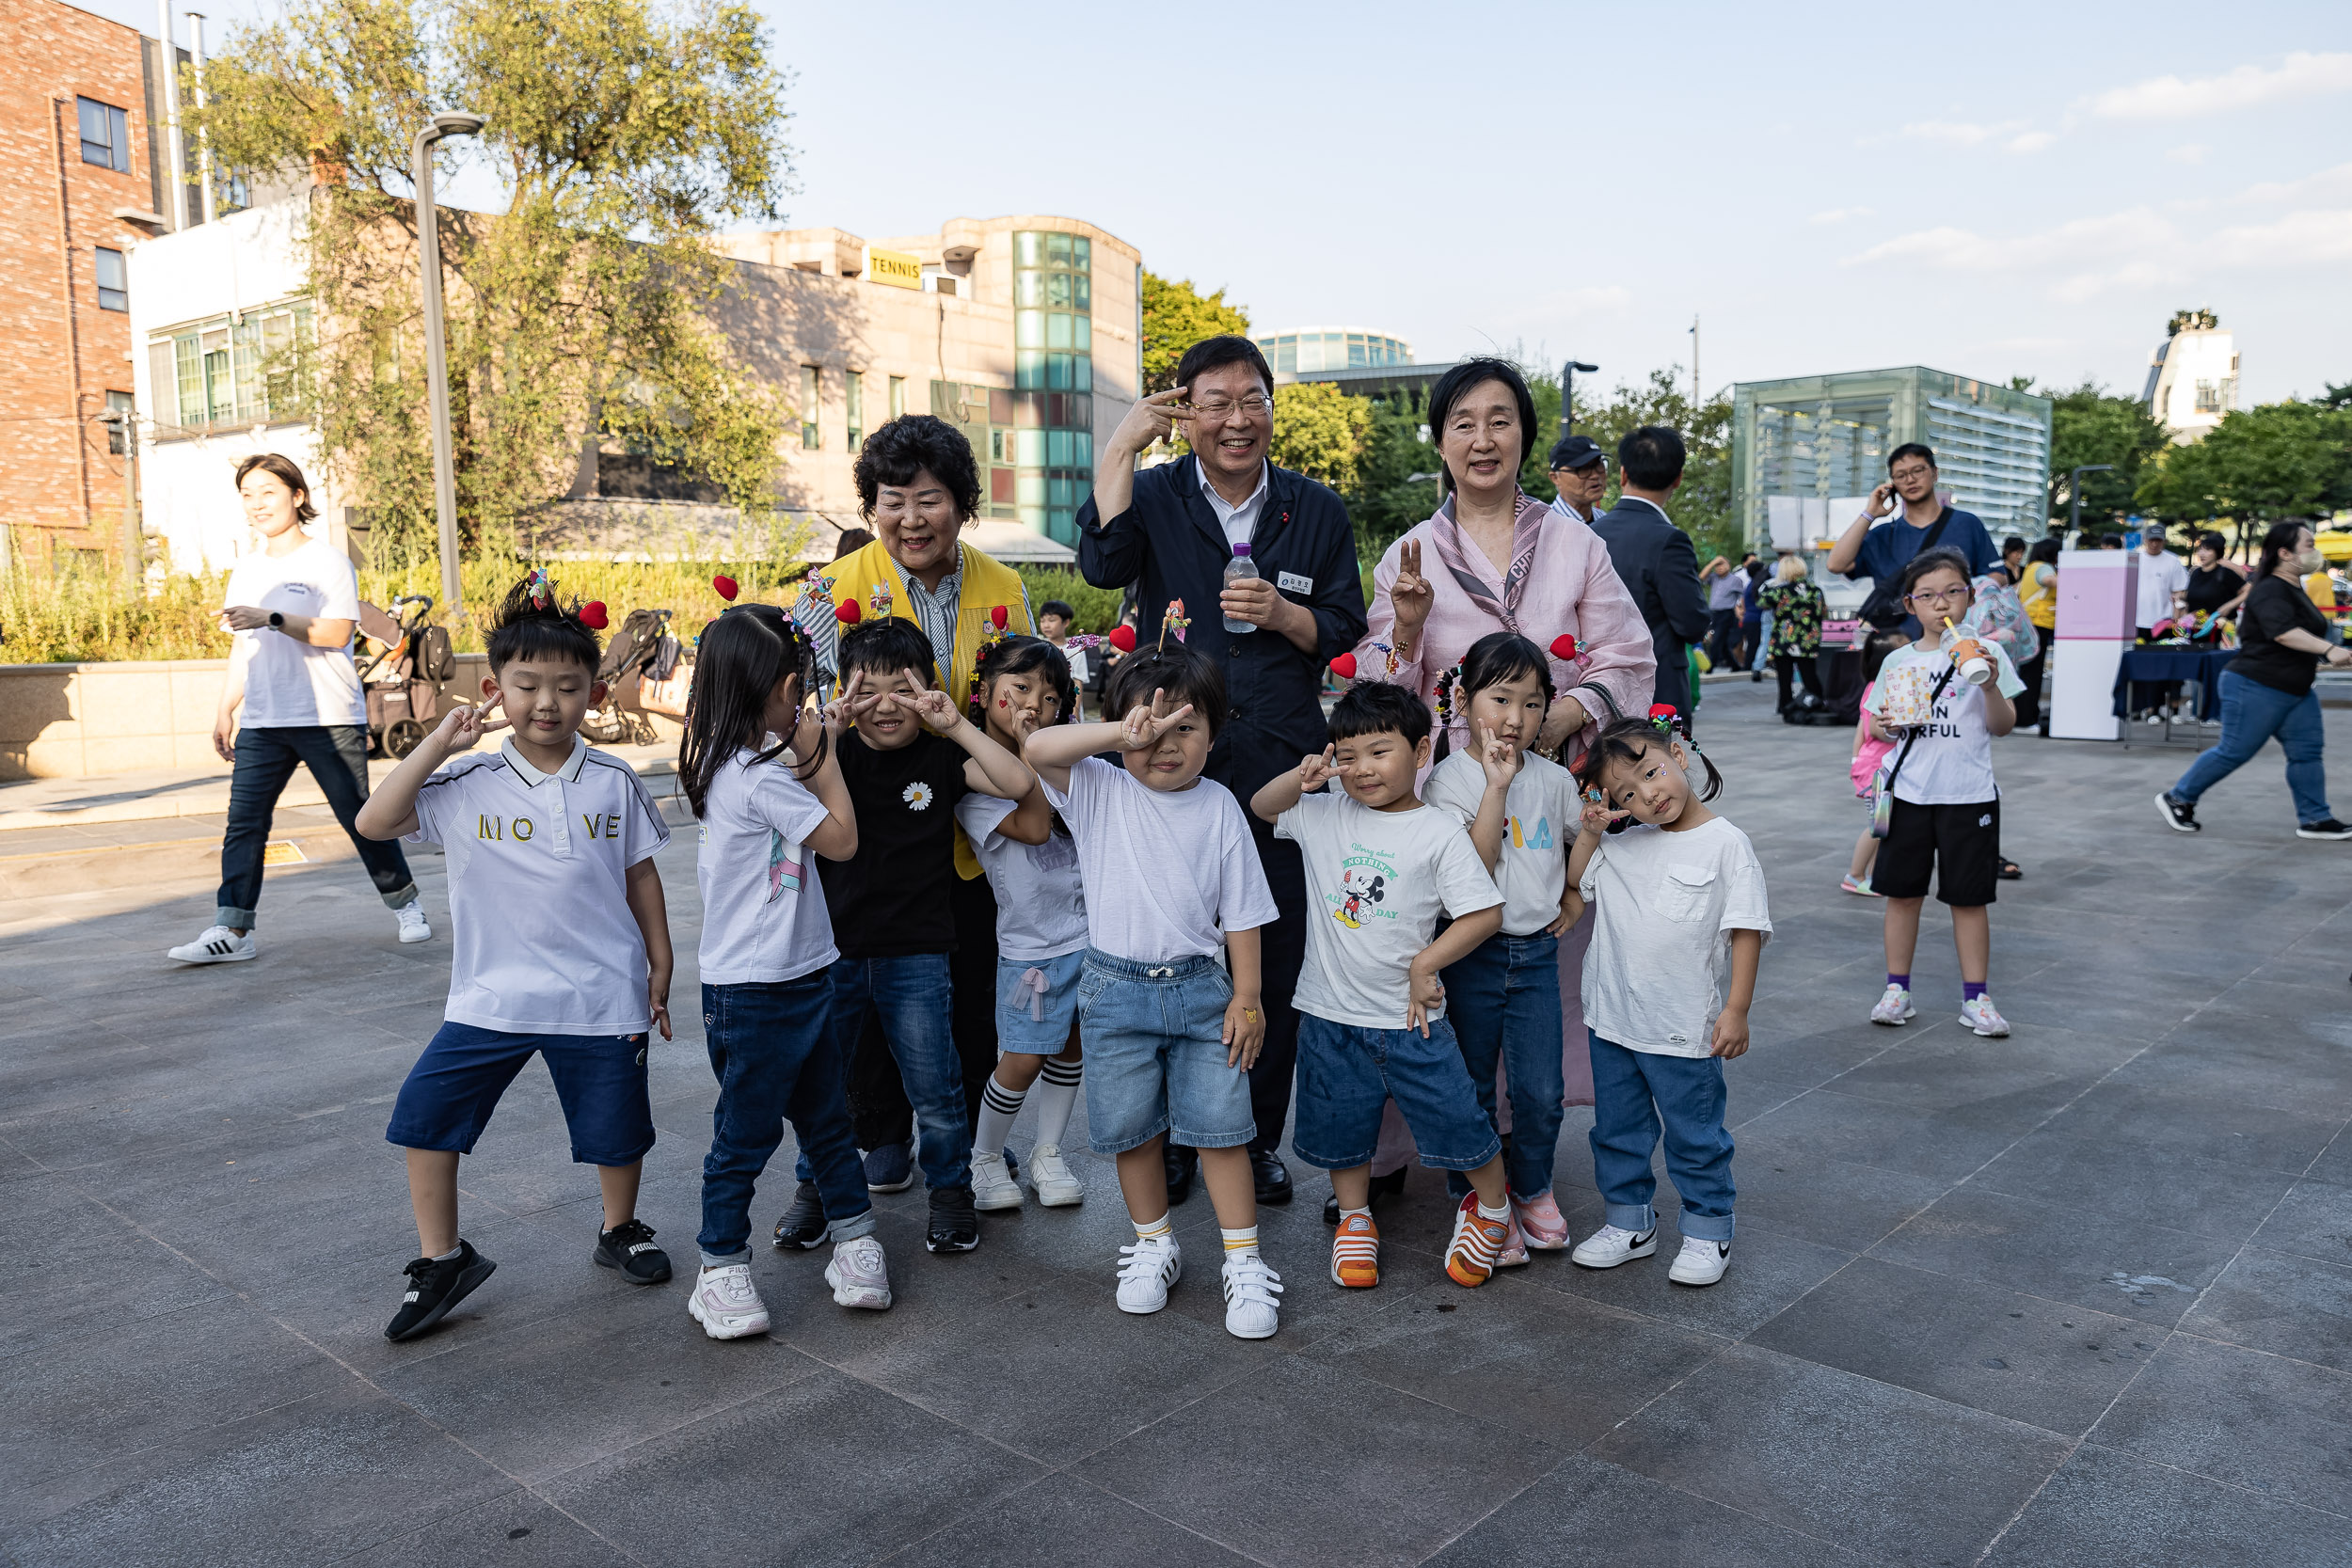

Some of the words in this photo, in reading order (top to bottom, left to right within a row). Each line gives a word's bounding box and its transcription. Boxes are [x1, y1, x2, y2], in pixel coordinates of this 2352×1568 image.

[872, 258, 920, 278] TENNIS
[1351, 842, 1375, 857] Worry
[1375, 849, 1396, 859] about
[1348, 857, 1391, 876] NOTHING
[1325, 893, 1343, 906] ALL
[1375, 908, 1399, 920] DAY
[728, 1266, 749, 1275] FILA
